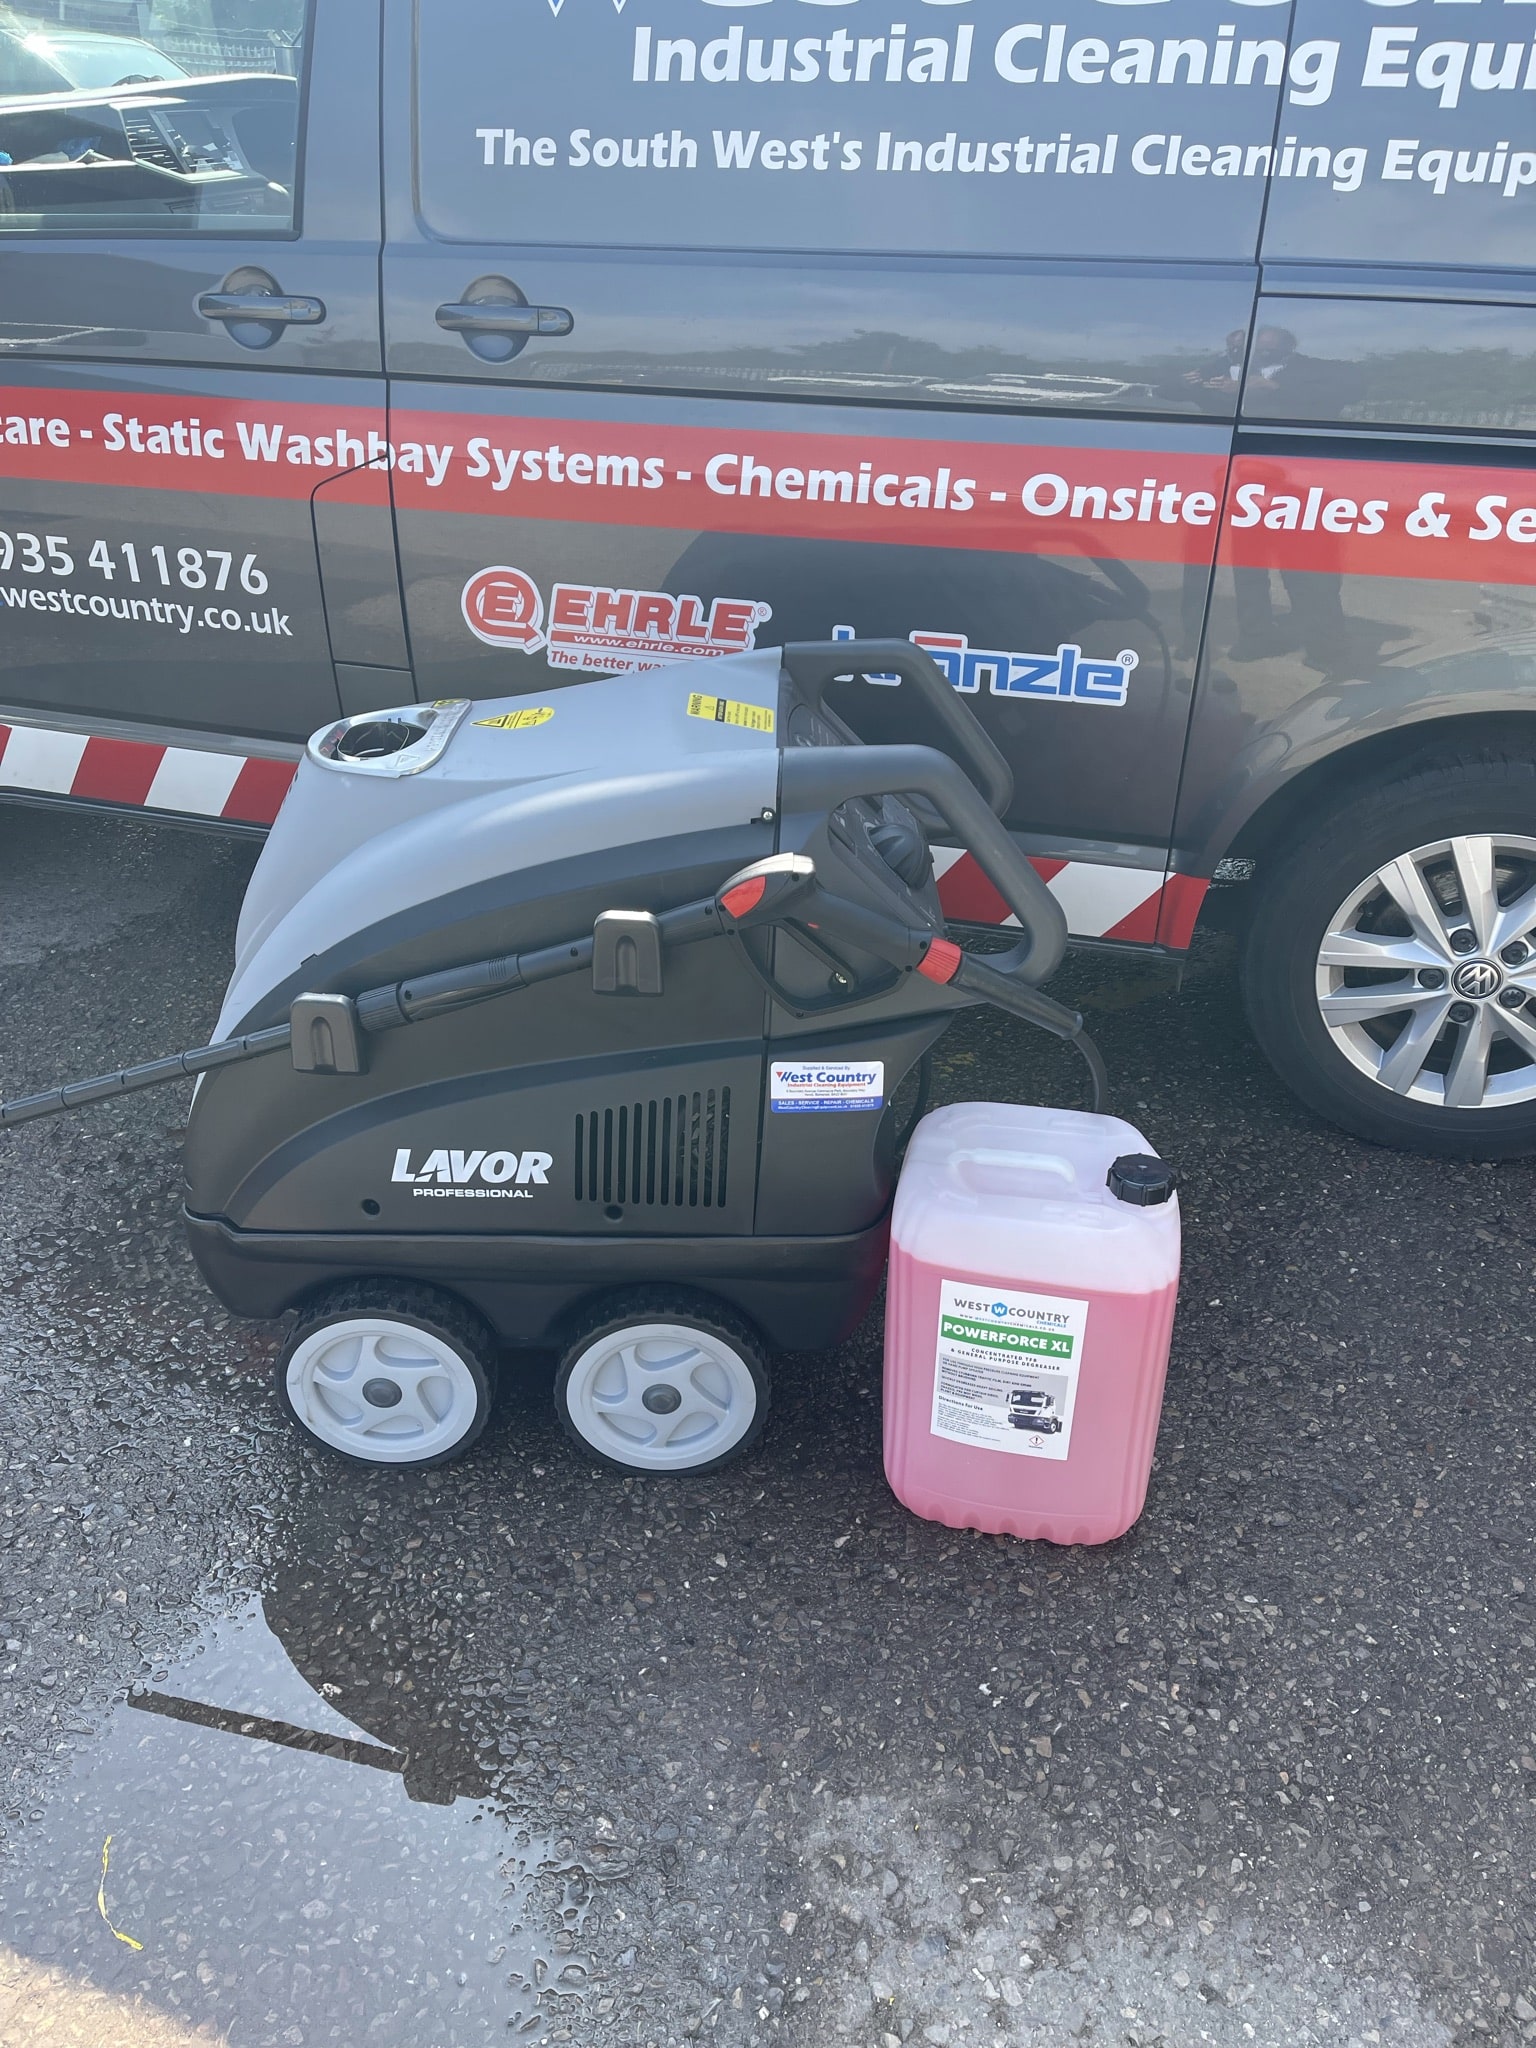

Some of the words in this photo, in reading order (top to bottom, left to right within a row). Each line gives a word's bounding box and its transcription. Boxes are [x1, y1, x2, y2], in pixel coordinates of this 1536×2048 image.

[632, 24, 975, 83] Industrial
[994, 23, 1341, 106] Cleaning
[476, 128, 556, 166] The
[568, 129, 698, 168] South
[712, 130, 863, 171] West's
[875, 131, 1119, 174] Industrial
[1131, 134, 1368, 192] Cleaning
[1381, 139, 1536, 197] Equip
[0, 416, 70, 448] are
[102, 413, 226, 459] Static
[236, 422, 453, 487] Washbay
[466, 437, 665, 491] Systems
[704, 453, 977, 511] Chemicals
[1021, 473, 1217, 526] Onsite
[1231, 483, 1389, 534] Sales
[1405, 492, 1451, 539] &
[1468, 495, 1536, 543] Se
[88, 539, 269, 596] 411876
[551, 587, 757, 646] EHRLE
[573, 633, 725, 657] www.ehrle.com
[551, 651, 578, 665] The
[582, 652, 634, 671] better
[776, 1071, 812, 1082] West
[816, 1072, 877, 1084] Country
[391, 1149, 553, 1184] LAVOR
[413, 1189, 533, 1198] PROFESSIONAL
[954, 1298, 991, 1312] WEST
[1009, 1307, 1070, 1324] COUNTRY
[943, 1321, 1047, 1350] POWERFORCE
[1051, 1340, 1070, 1353] XL
[957, 1350, 986, 1360] GENERAL
[989, 1356, 1019, 1366] PURPOSE
[1021, 1361, 1061, 1371] DEGREASER
[971, 1348, 1023, 1361] CONCENTRATED
[938, 1395, 964, 1407] Directions
